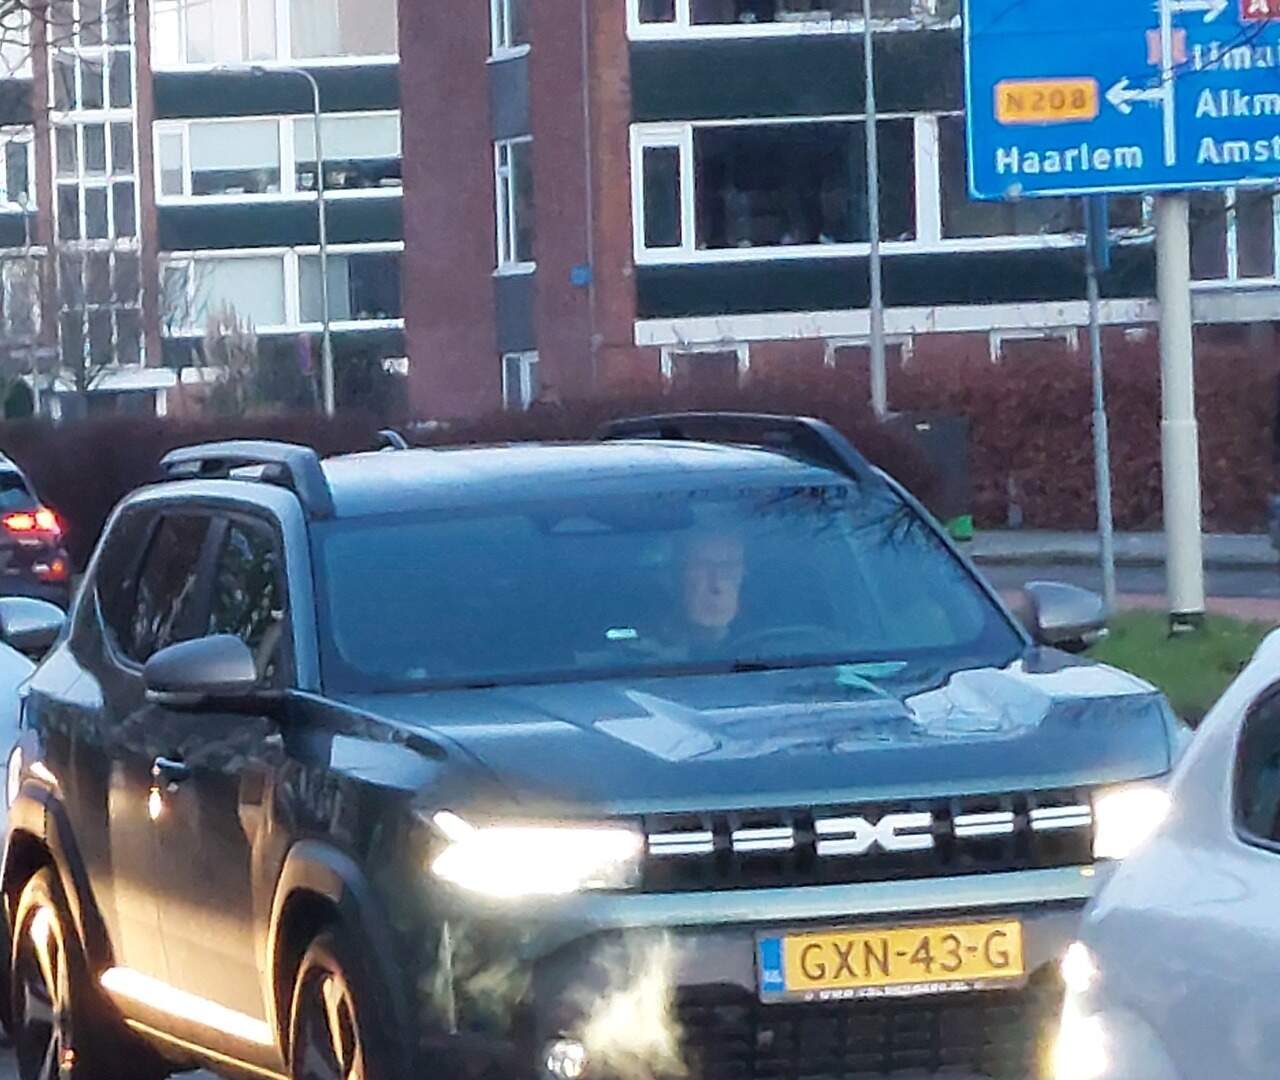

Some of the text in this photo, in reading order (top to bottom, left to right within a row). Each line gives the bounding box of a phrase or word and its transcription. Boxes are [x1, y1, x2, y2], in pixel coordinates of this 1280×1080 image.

[1004, 88, 1088, 114] N208
[995, 142, 1144, 174] Haarlem
[800, 929, 1010, 981] GXN-43-G
